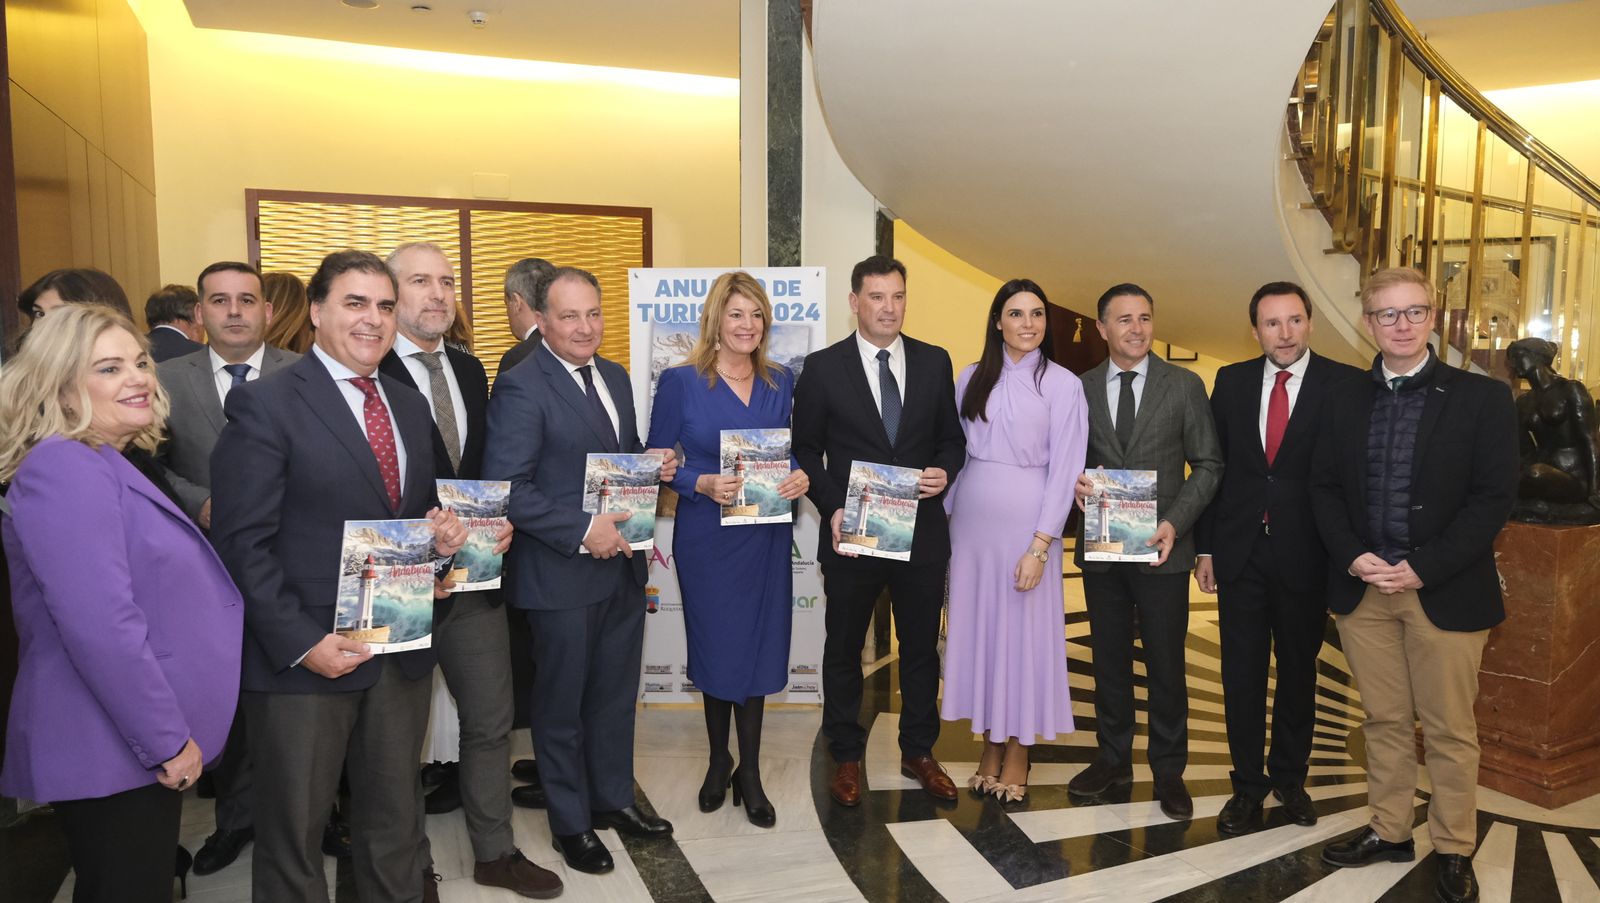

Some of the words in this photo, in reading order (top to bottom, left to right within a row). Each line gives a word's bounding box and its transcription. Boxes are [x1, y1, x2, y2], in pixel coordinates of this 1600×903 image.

[773, 280, 801, 296] DE
[637, 303, 704, 322] TURI
[771, 302, 820, 321] 024
